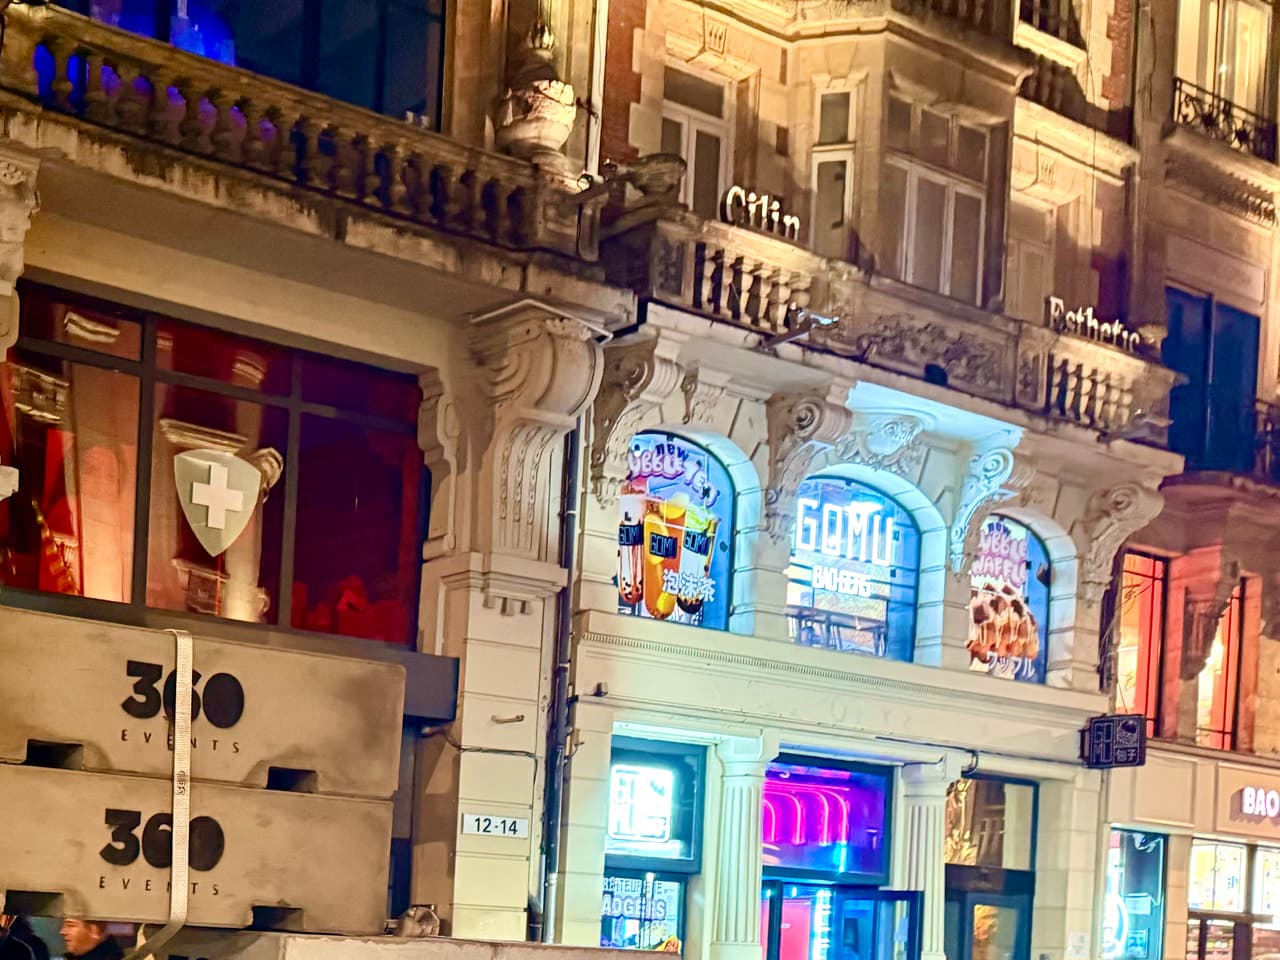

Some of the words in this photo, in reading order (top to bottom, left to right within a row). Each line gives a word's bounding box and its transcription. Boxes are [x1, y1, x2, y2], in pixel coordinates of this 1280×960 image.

[796, 498, 894, 567] GOMU
[1242, 786, 1280, 818] BAO
[99, 808, 225, 872] 360
